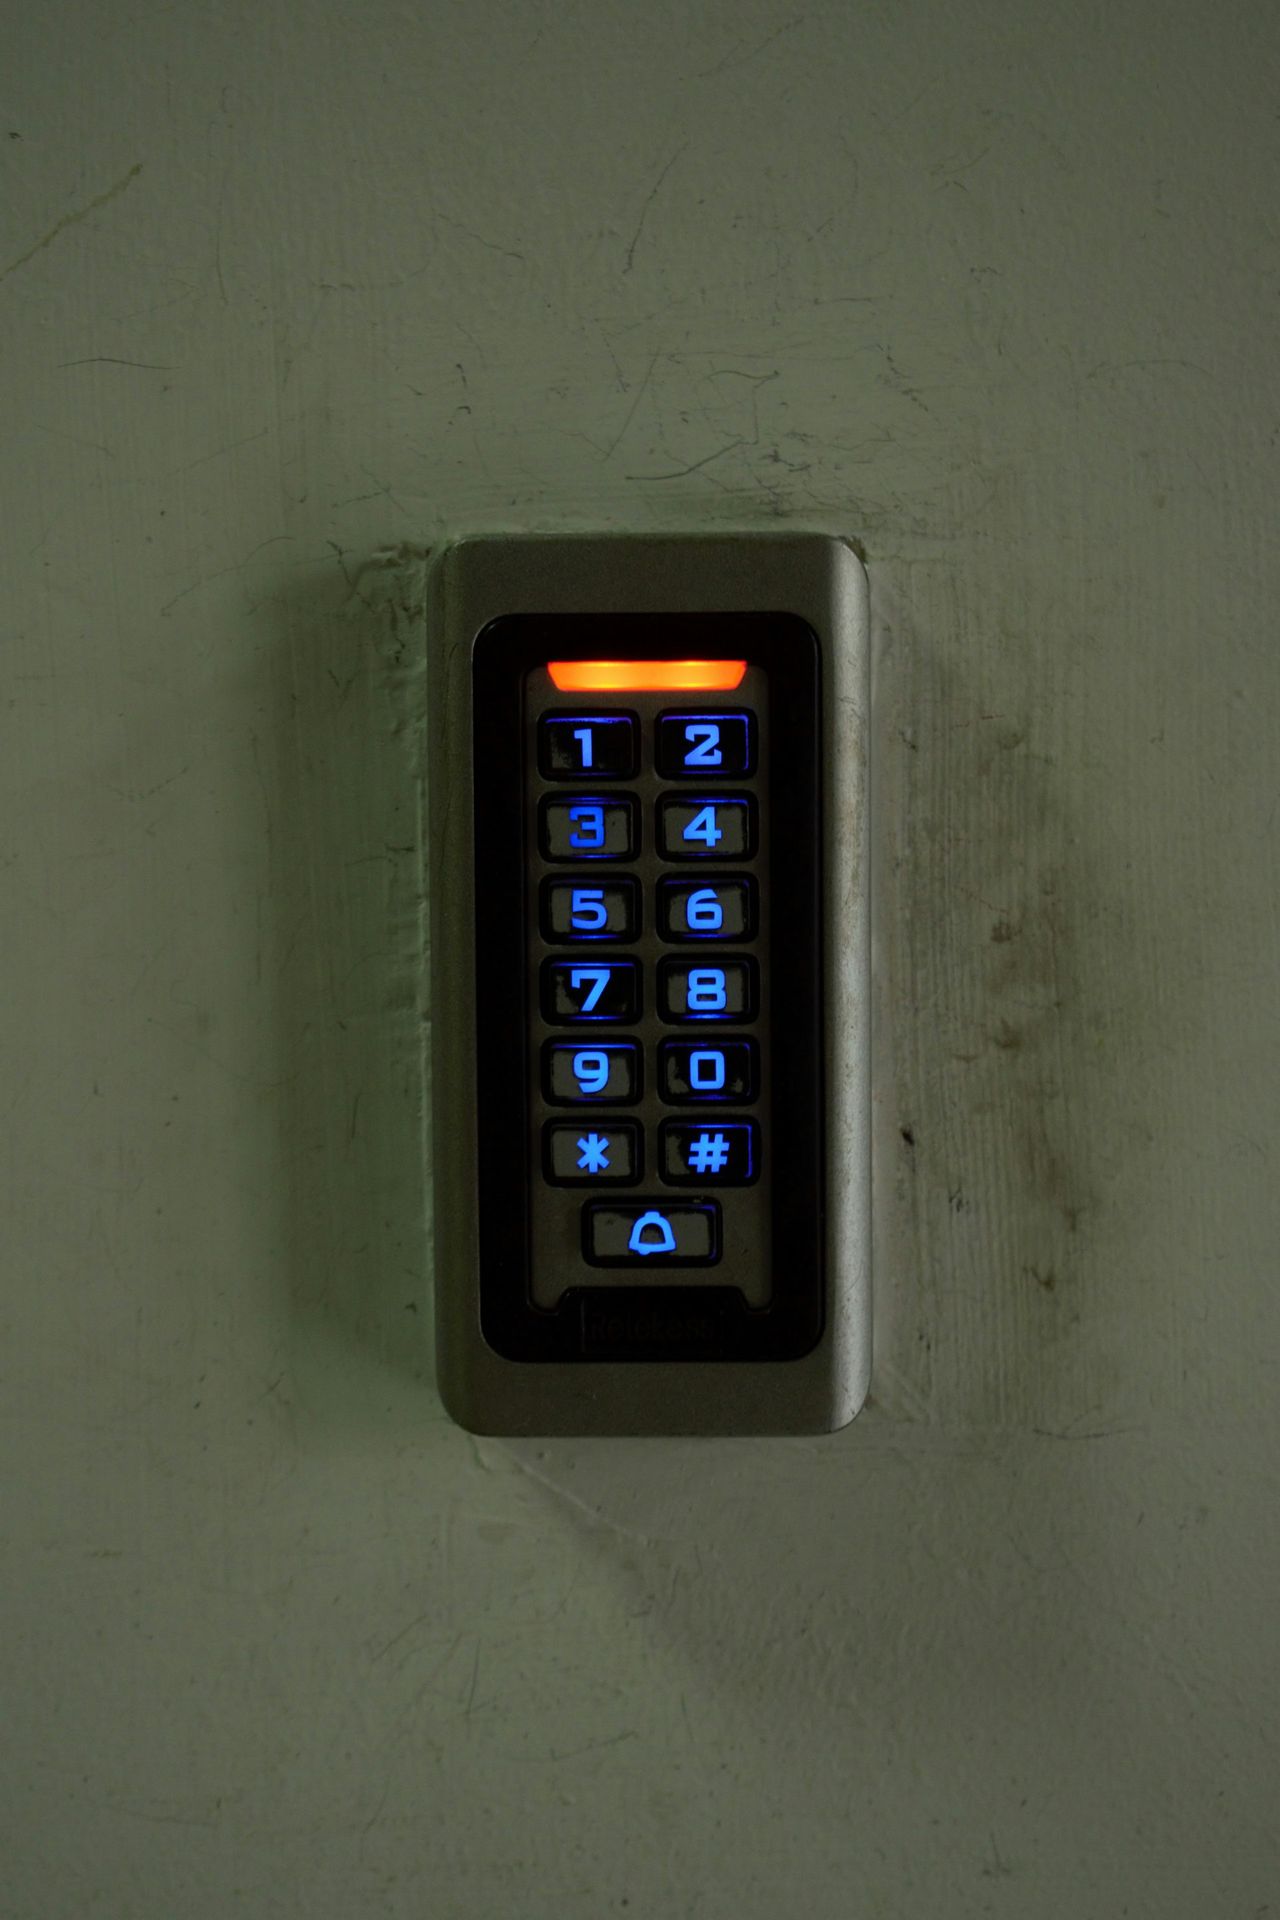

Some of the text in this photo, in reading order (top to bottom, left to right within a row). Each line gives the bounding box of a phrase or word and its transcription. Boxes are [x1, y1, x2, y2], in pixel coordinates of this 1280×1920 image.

[573, 728, 593, 767] 1
[684, 723, 723, 766] 2
[569, 806, 606, 849] 3
[683, 806, 722, 847] 4
[571, 889, 608, 930] 5
[686, 888, 723, 930] 6
[571, 968, 611, 1012] 7
[687, 968, 727, 1011] 8
[573, 1051, 609, 1093] 9
[689, 1050, 726, 1090] 0
[688, 1133, 730, 1173] #
